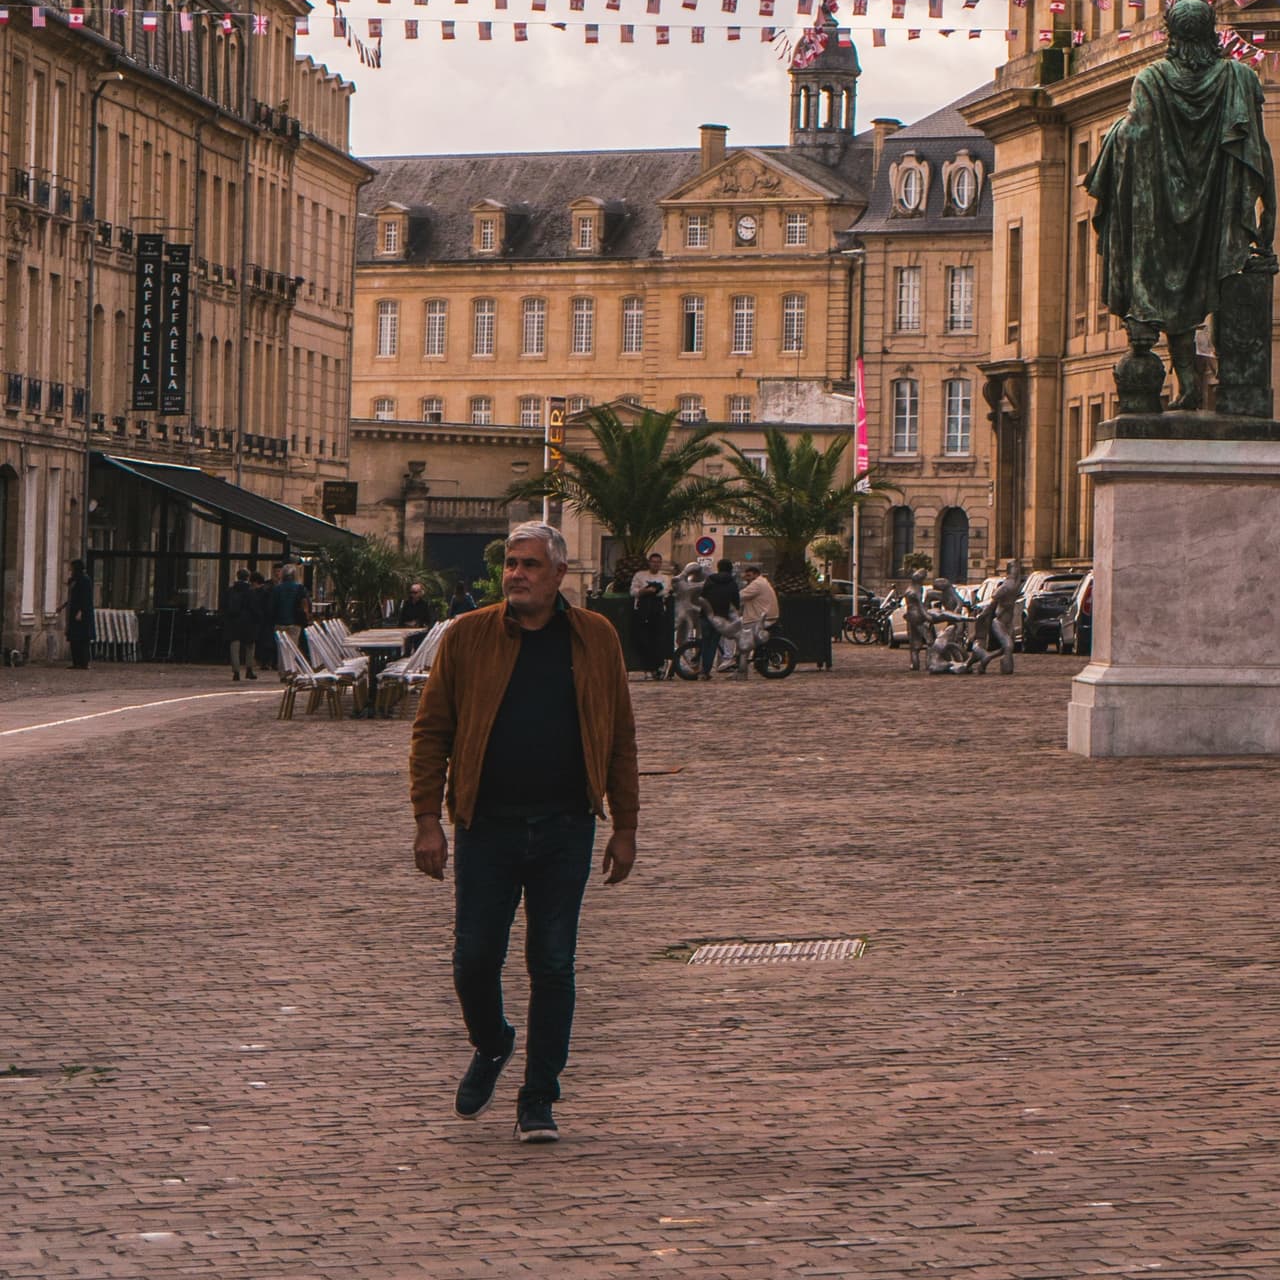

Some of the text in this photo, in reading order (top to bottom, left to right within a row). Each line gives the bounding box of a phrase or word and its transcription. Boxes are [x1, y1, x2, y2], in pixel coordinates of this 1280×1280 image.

[140, 263, 154, 384] RAFFAELLA
[167, 272, 182, 390] RAFFAELLA
[550, 409, 564, 476] KER
